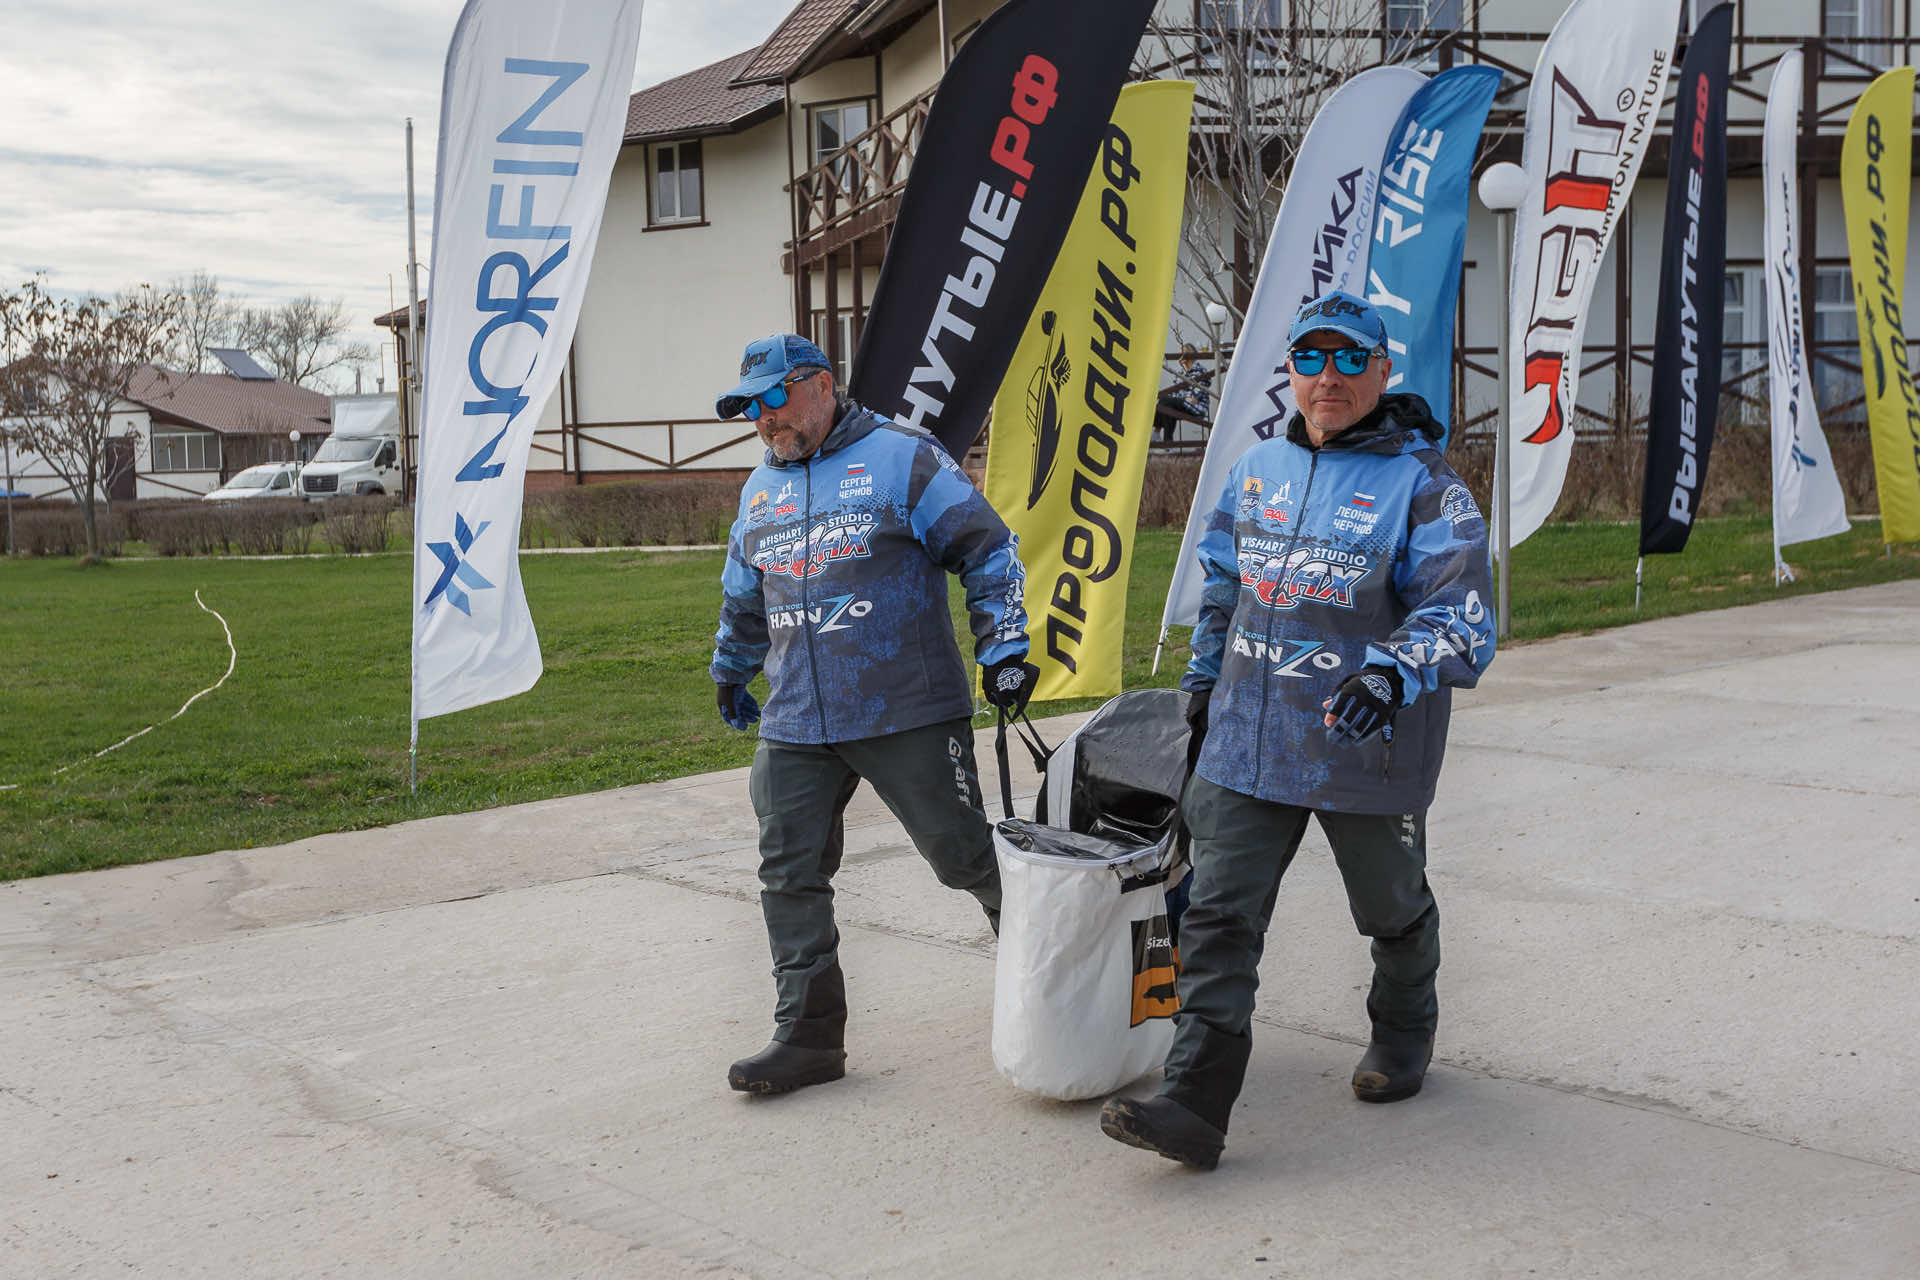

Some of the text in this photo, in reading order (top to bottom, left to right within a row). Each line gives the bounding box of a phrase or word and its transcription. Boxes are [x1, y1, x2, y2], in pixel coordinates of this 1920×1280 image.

[1626, 48, 1667, 144] NATURE
[894, 54, 1059, 437] НУТЫЕ.РФ
[455, 57, 590, 483] NORFIN
[840, 475, 873, 489] СЕРГЕЙ
[839, 486, 873, 500] ЧЕРНОВ
[828, 513, 873, 527] STUDIO
[1335, 505, 1380, 524] ЛЕОНИД
[1334, 518, 1374, 536] ЧЕРНОВ
[1312, 547, 1367, 567] STUDIO
[769, 592, 873, 634] HANZO
